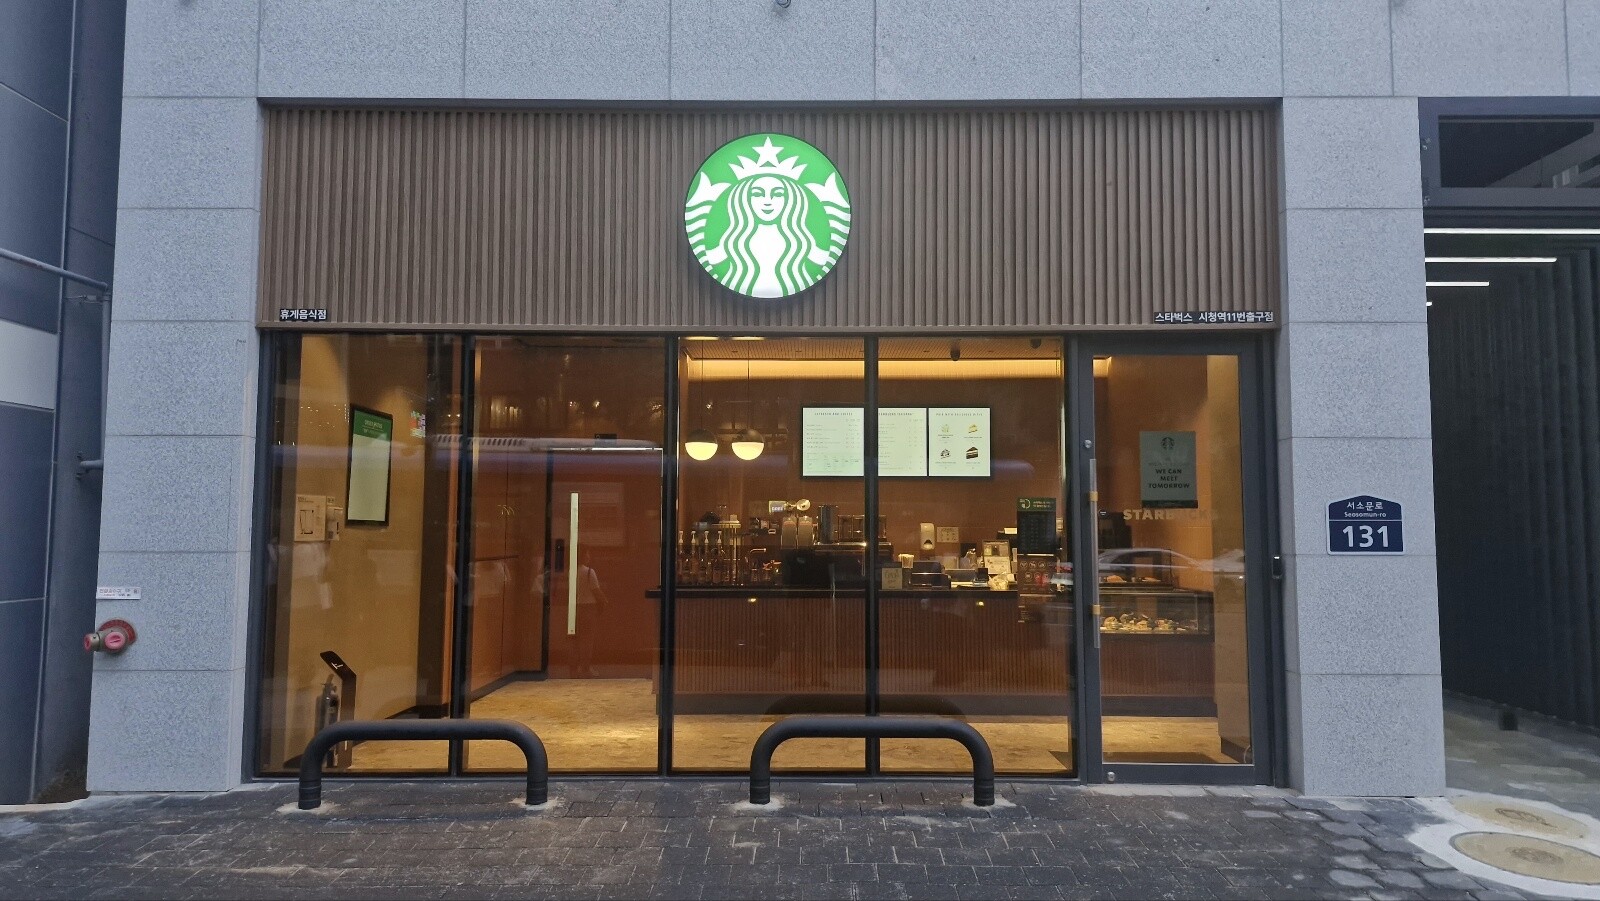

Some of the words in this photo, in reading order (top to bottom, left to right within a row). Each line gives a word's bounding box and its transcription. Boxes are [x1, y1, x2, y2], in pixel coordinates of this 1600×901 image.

[280, 309, 327, 320] 휴게음식점
[1155, 312, 1193, 322] 스타벅스
[1199, 311, 1274, 322] 시청역11번출구점
[1346, 501, 1384, 511] 서소문로
[1342, 525, 1389, 548] 131
